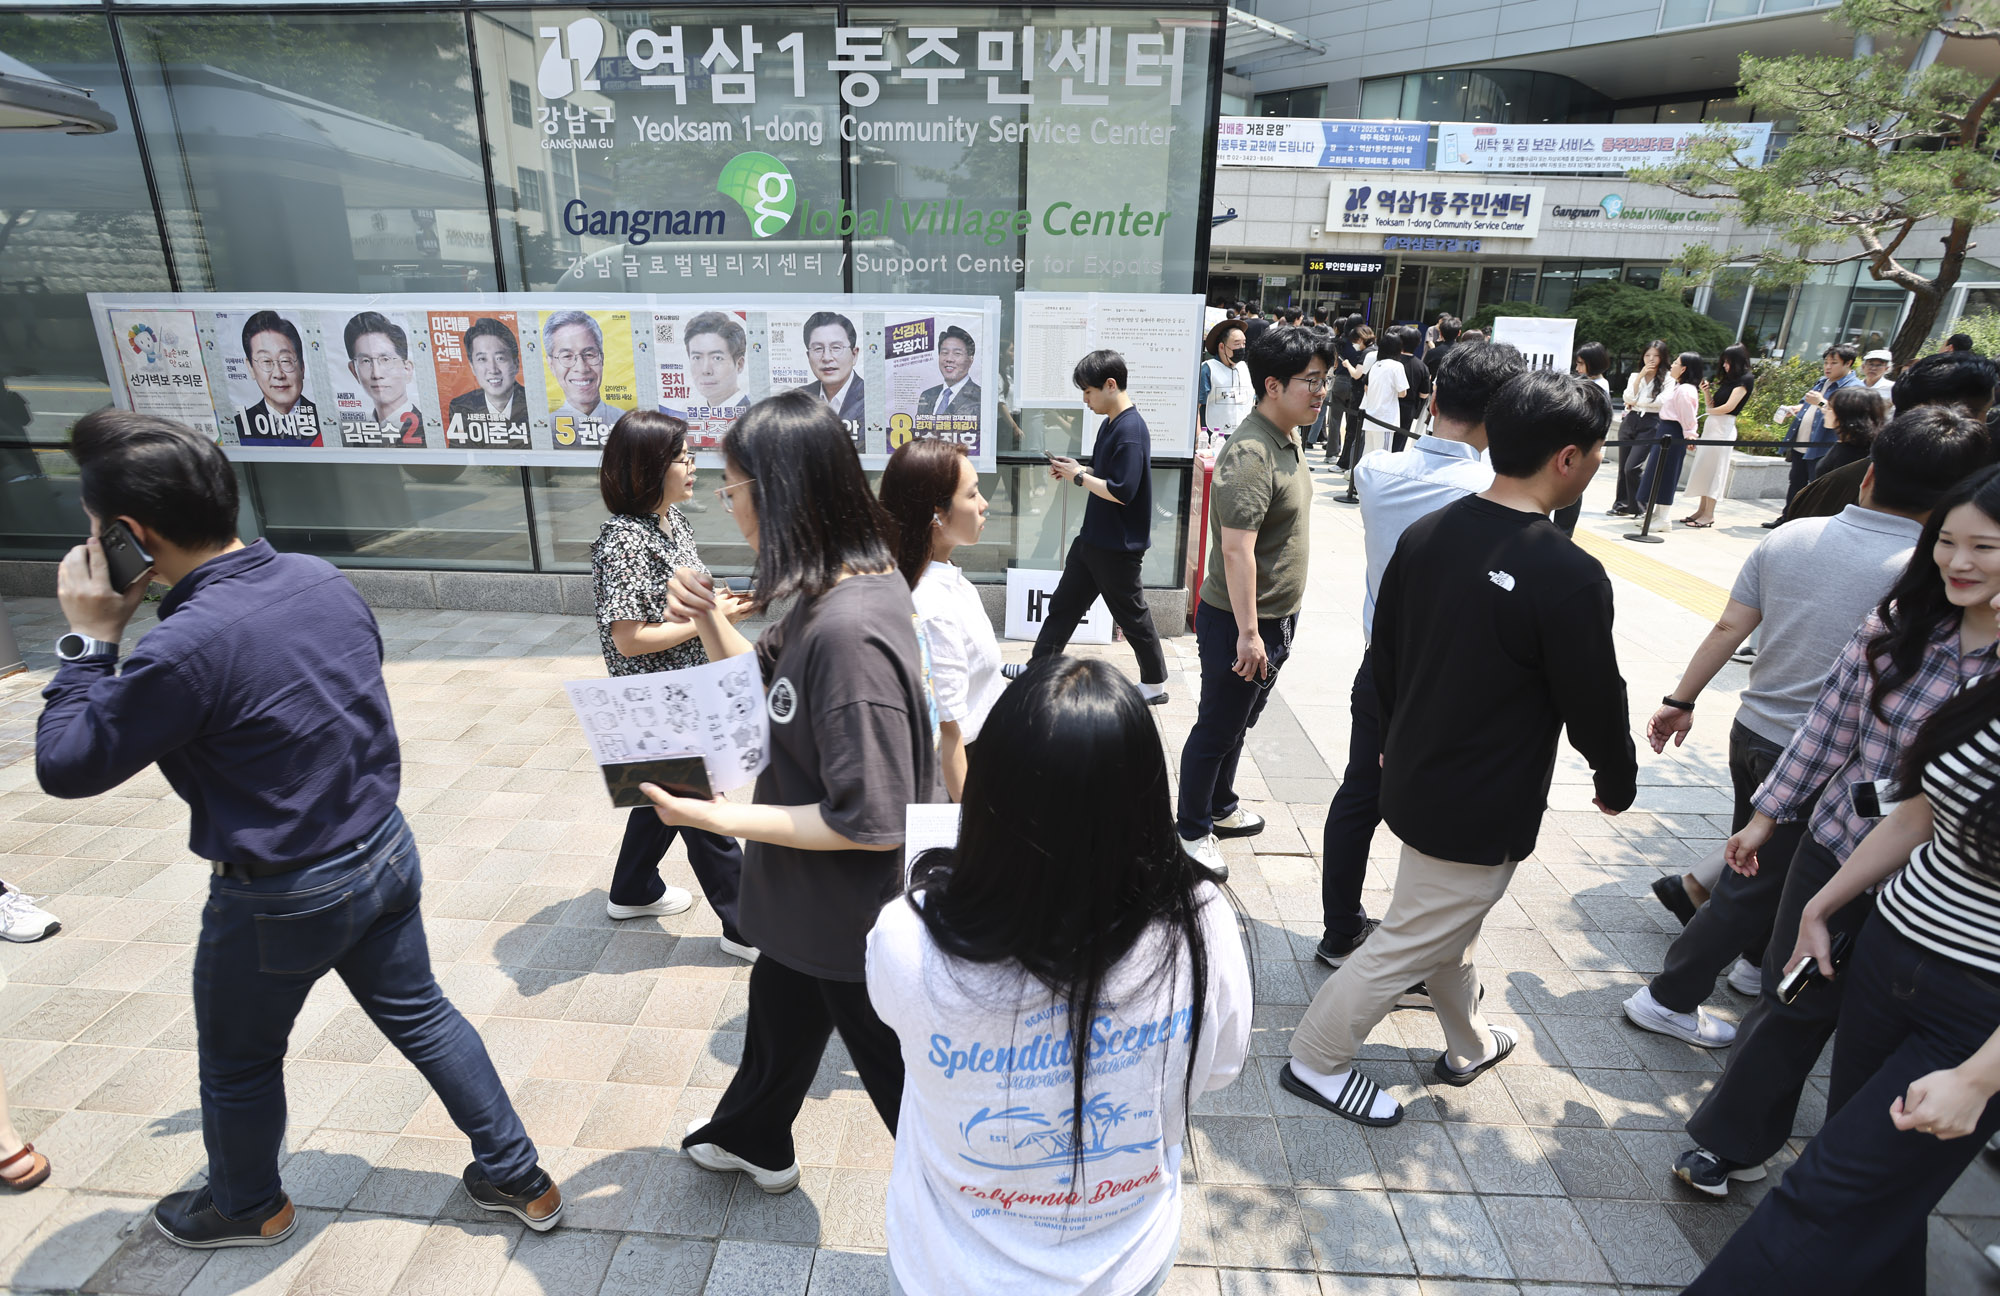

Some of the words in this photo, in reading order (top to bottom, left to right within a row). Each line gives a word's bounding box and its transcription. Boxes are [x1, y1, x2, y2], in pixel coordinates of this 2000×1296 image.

[626, 25, 1185, 107] 역삼1동주민센터
[537, 106, 614, 135] 강남구
[1246, 124, 1264, 135] 거점
[632, 115, 732, 142] Yeoksam
[741, 115, 823, 145] 1-dong
[840, 114, 979, 147] Community
[989, 115, 1080, 144] Service
[1091, 116, 1176, 145] Center
[541, 138, 597, 149] GANGNAM
[599, 138, 614, 149] GU
[1217, 139, 1248, 153] 봉투로
[1250, 140, 1276, 153] 교환해
[1279, 141, 1315, 153] 드립니다
[1474, 138, 1499, 151] 세탁
[1502, 138, 1513, 151] 및
[1516, 138, 1529, 151] 짐
[1532, 139, 1556, 151] 보관
[1559, 138, 1594, 151] 서비스
[1602, 137, 1674, 152] 동주민센터로
[1377, 189, 1531, 217] 역삼1동주민센터
[564, 199, 725, 245] Gangnam
[901, 199, 1032, 246] Village
[1043, 201, 1172, 236] Center
[1343, 213, 1369, 223] 강남구
[1552, 205, 1600, 219] Gangnam
[1648, 208, 1687, 224] Village
[1375, 217, 1404, 227] Yeoksam
[1408, 218, 1431, 229] 1-dong
[1434, 219, 1473, 230] Community
[1474, 220, 1500, 230] Service
[1502, 222, 1525, 231] Center
[1399, 237, 1460, 252] 역삼로7길
[1464, 240, 1481, 252] 16
[567, 253, 822, 279] 강남글로벌빌리지센터
[856, 253, 948, 275] Support
[956, 254, 1034, 272] Center
[1043, 255, 1074, 272] for
[1084, 255, 1163, 276] Expats
[1310, 262, 1324, 270] 365
[432, 316, 470, 332] 미래를
[892, 322, 928, 340] 선경제,
[434, 332, 460, 347] 여는
[892, 336, 929, 355] 후정치!
[436, 347, 462, 362] 선택
[130, 373, 170, 387] 선거벽보
[172, 374, 203, 387] 주의문
[661, 373, 685, 385] 정치
[663, 387, 690, 399] 교체!
[255, 414, 318, 437] 이재명
[342, 422, 401, 443] 김문수
[400, 412, 423, 444] 2
[446, 412, 469, 444] 4
[468, 422, 529, 444] 이준석
[555, 416, 576, 445] 5
[578, 424, 614, 446] 권영
[687, 420, 736, 443] 구주
[890, 412, 913, 450] 8
[928, 1030, 1073, 1080] Splendid
[1134, 1110, 1154, 1120] 1987
[990, 1134, 1009, 1144] EST.
[960, 1184, 1083, 1210] California
[1088, 1165, 1161, 1205] Beach
[971, 1208, 991, 1219] LOOK
[992, 1208, 1001, 1216] AT
[1105, 1209, 1118, 1218] THE
[1120, 1195, 1145, 1213] PICTURE
[1034, 1221, 1067, 1231] SUMMER
